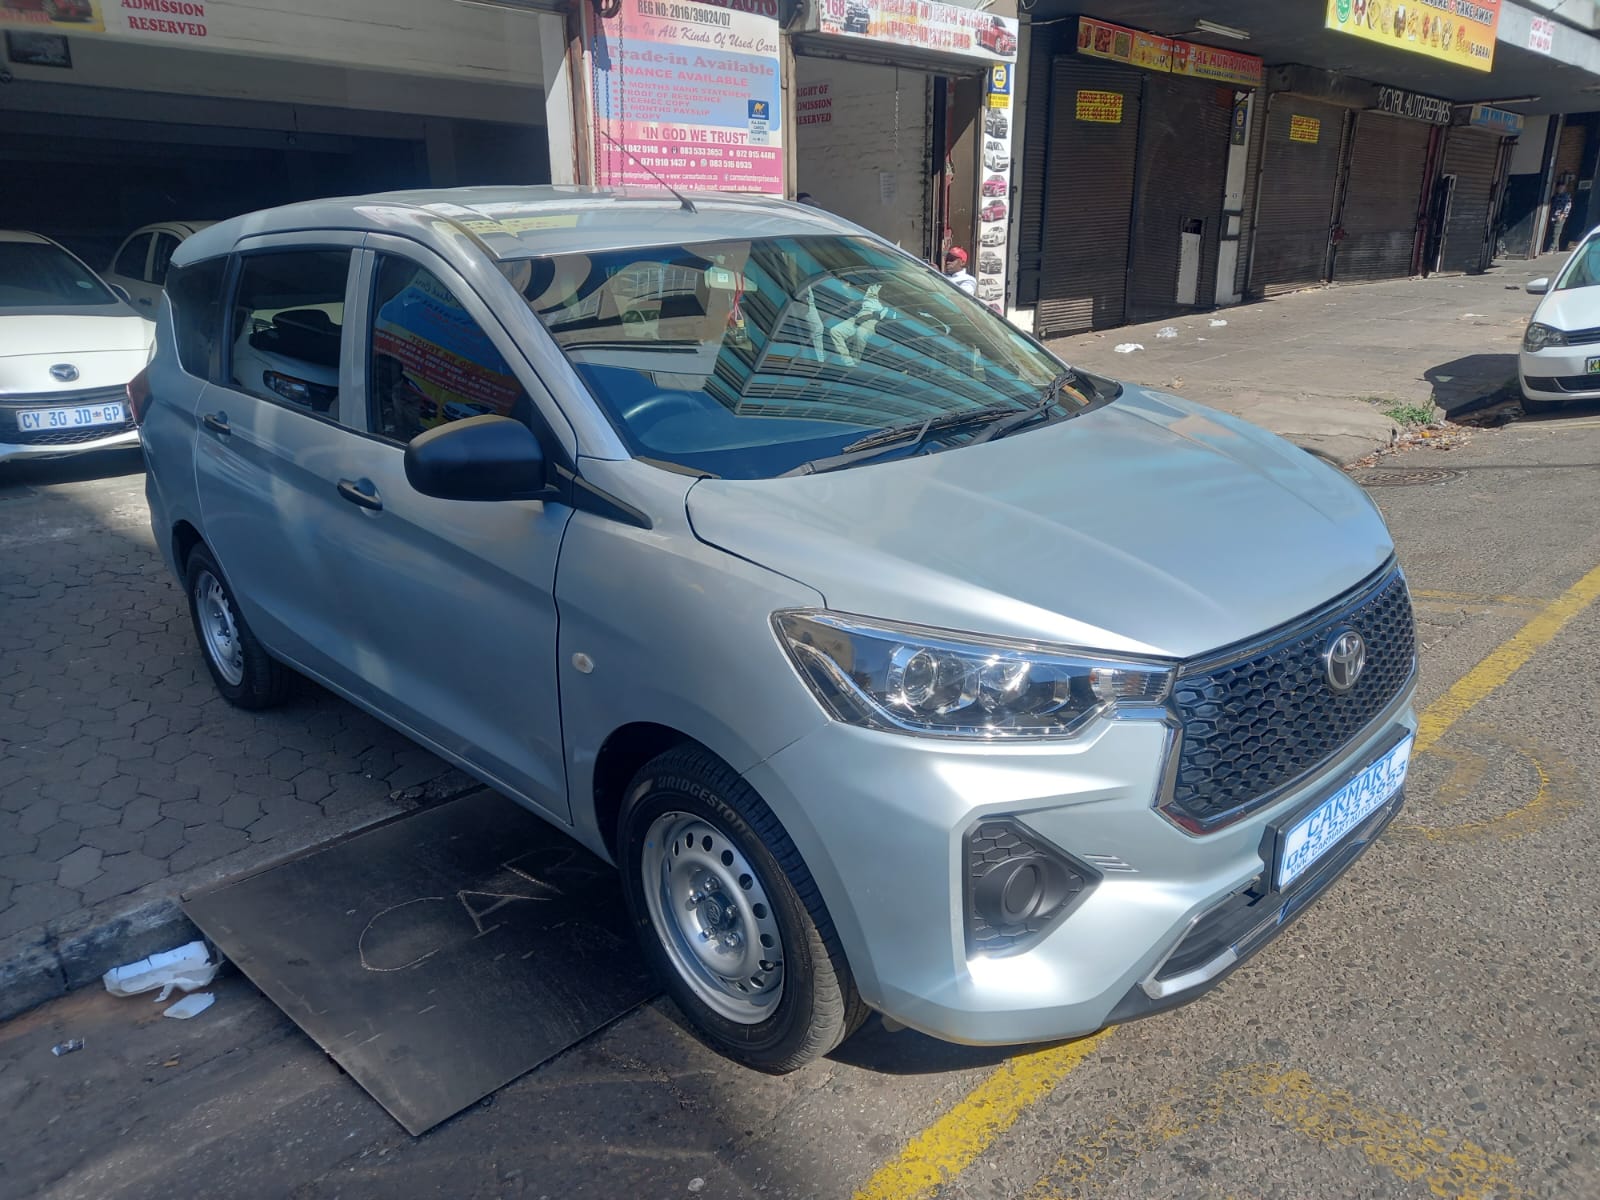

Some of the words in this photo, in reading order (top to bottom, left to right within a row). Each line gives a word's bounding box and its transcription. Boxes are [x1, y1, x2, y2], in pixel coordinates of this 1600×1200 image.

[122, 0, 204, 16] ADMISSION
[638, 0, 653, 14] REG
[655, 2, 668, 16] NO:
[670, 4, 730, 26] 2016/39024/07
[825, 0, 845, 17] 168
[1456, 1, 1473, 17] TAKE
[1474, 6, 1494, 24] AWAY
[128, 16, 207, 37] RESERVED
[658, 24, 677, 38] All
[680, 27, 710, 42] Kinds
[714, 32, 725, 48] Of
[729, 34, 753, 49] Used
[755, 38, 777, 52] Cars
[610, 64, 672, 78] FNANCE
[678, 71, 748, 87] AVAILABLE
[693, 56, 774, 76] Available
[819, 84, 829, 94] OF
[797, 98, 832, 111] DMISSION
[662, 128, 686, 140] GOD
[690, 129, 707, 141] WE
[22, 413, 40, 428] CY
[49, 411, 67, 426] 30
[75, 409, 91, 424] JD
[103, 406, 119, 421] GP
[1307, 751, 1396, 838] CARMART
[1287, 832, 1322, 870] 083
[1327, 803, 1360, 835] 533
[1365, 761, 1406, 803] 3653
